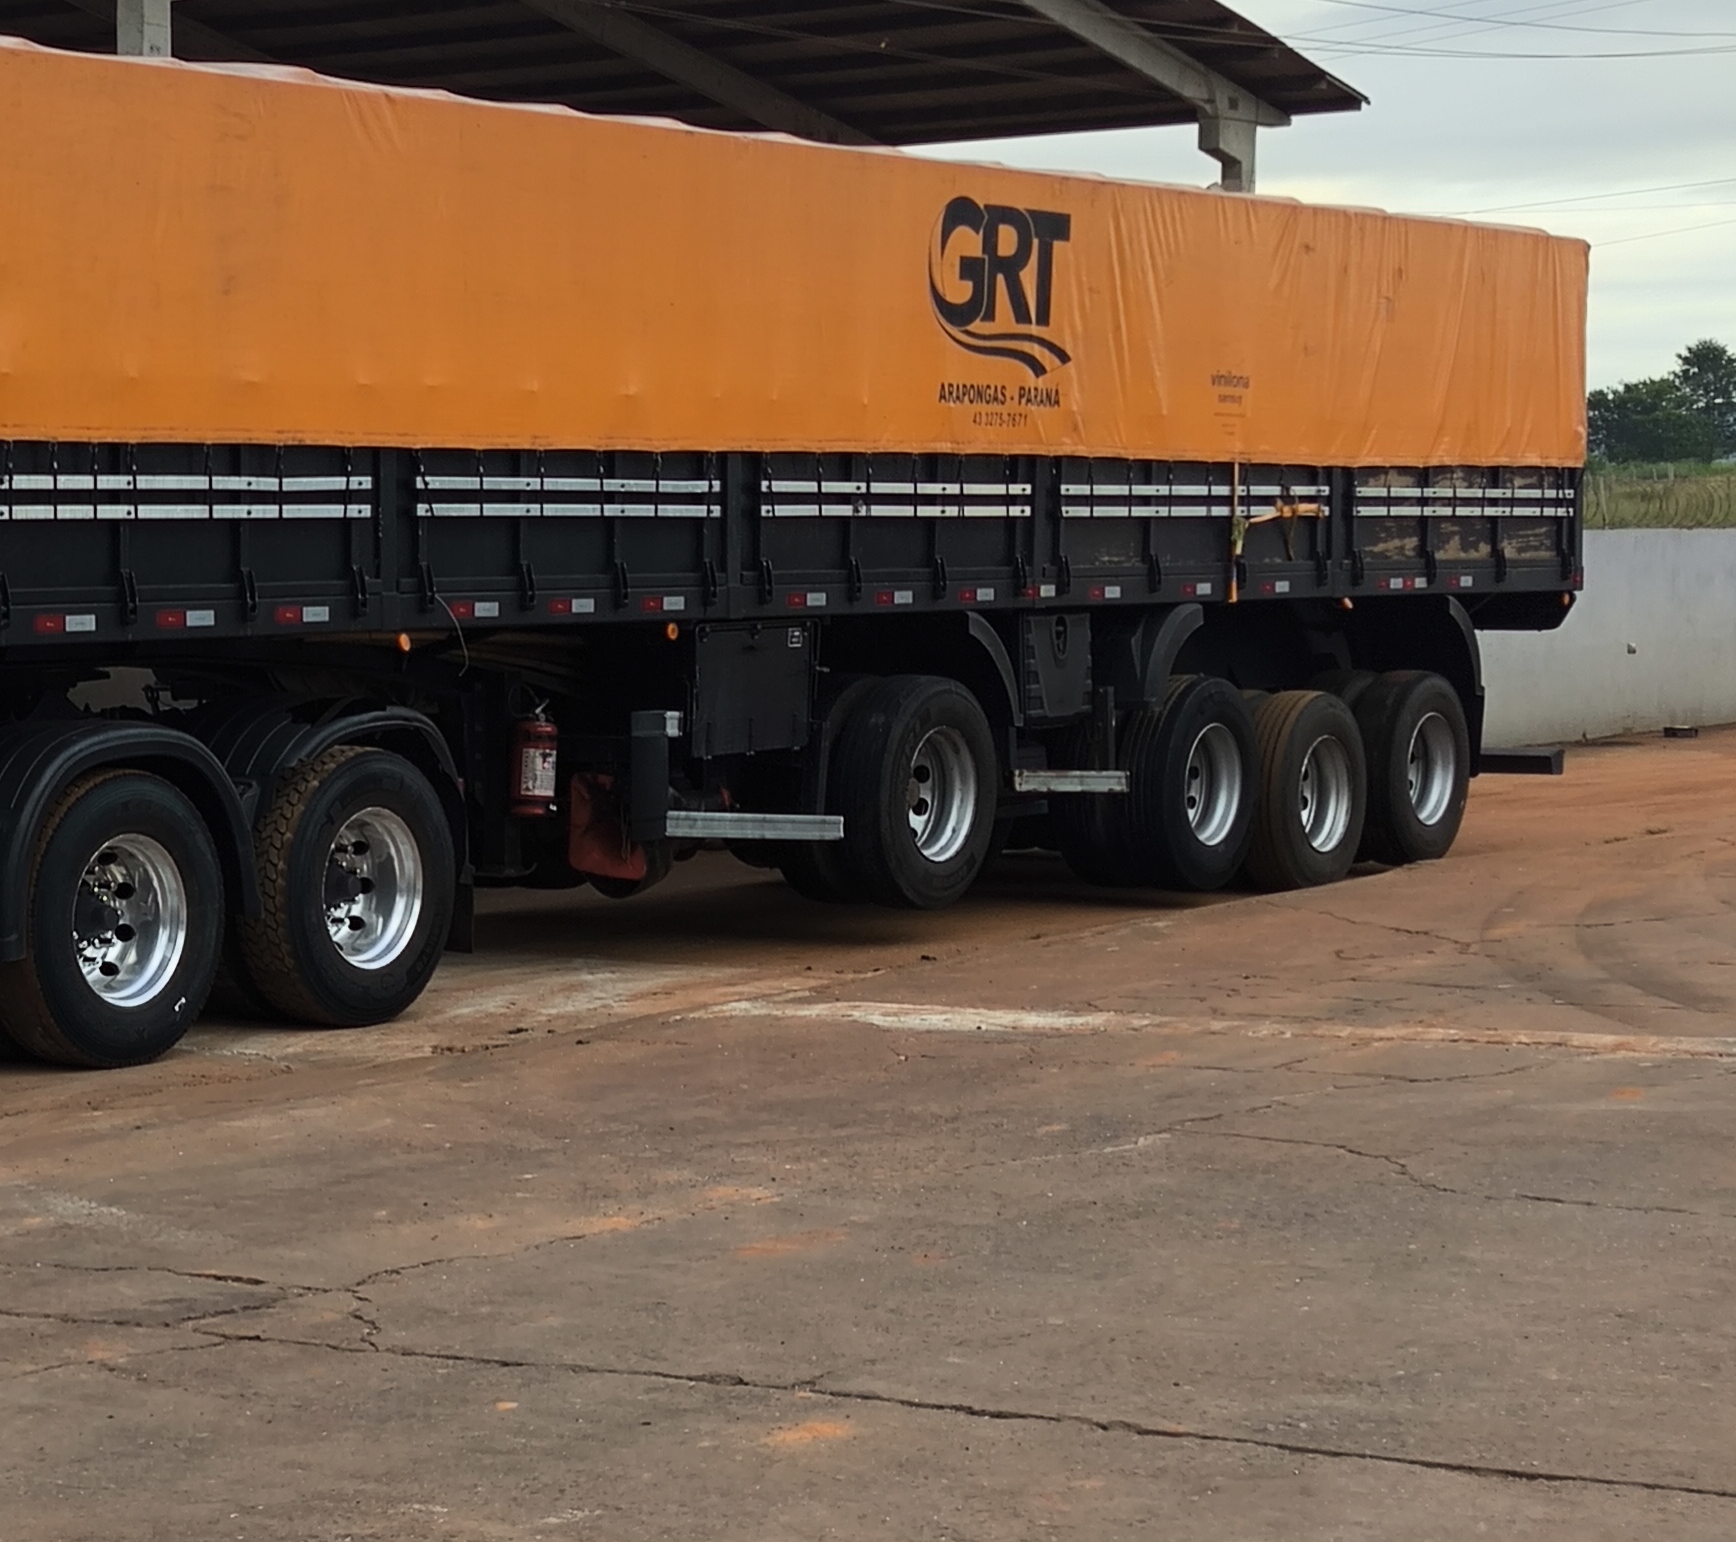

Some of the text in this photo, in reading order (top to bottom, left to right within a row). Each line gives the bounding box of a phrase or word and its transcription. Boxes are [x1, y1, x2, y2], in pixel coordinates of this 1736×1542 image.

[929, 196, 1072, 330] GRT
[938, 382, 1007, 406] ARAPONGAS
[1017, 383, 1061, 408] PARANÁ
